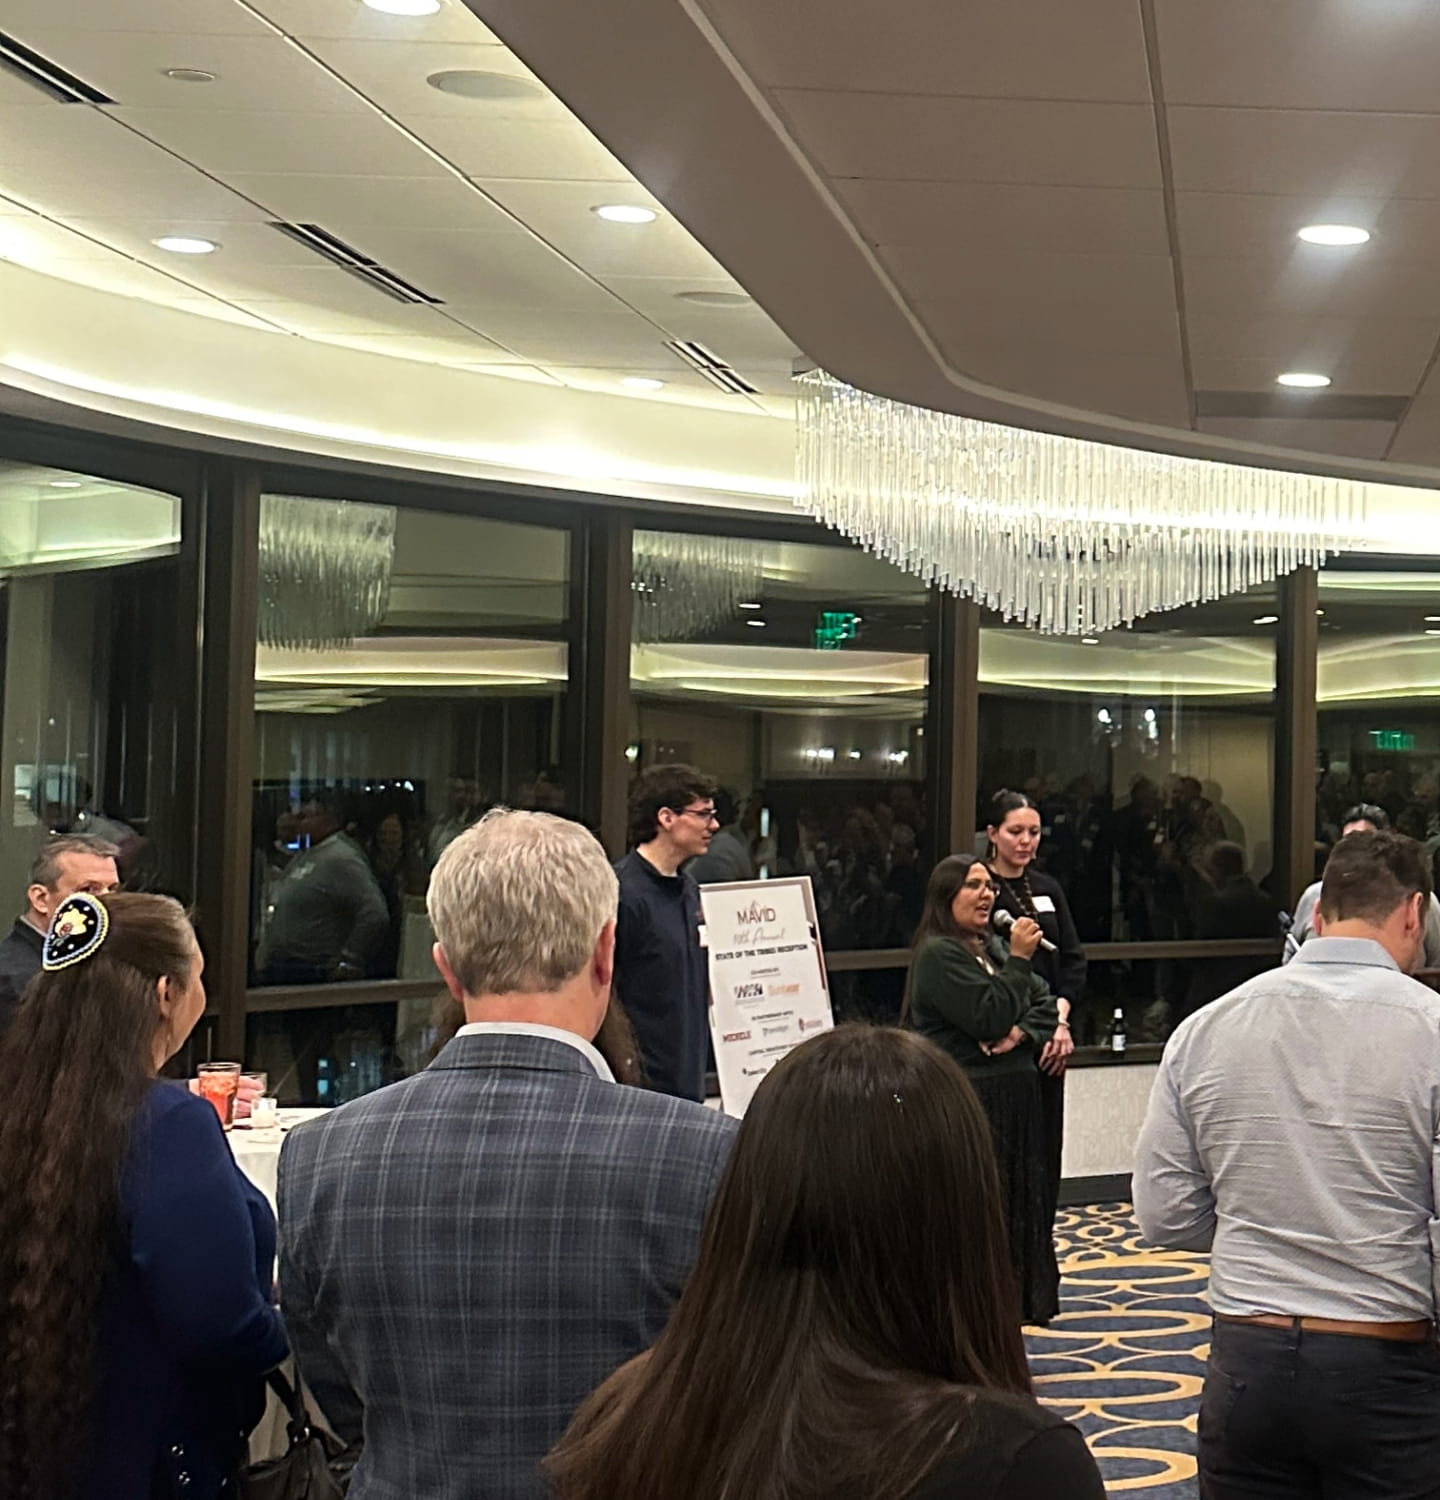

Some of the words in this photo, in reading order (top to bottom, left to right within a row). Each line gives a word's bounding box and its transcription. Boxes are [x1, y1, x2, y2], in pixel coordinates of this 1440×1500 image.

[737, 907, 776, 925] MAVID
[715, 952, 734, 960] STATE
[777, 944, 808, 953] RECEPTION
